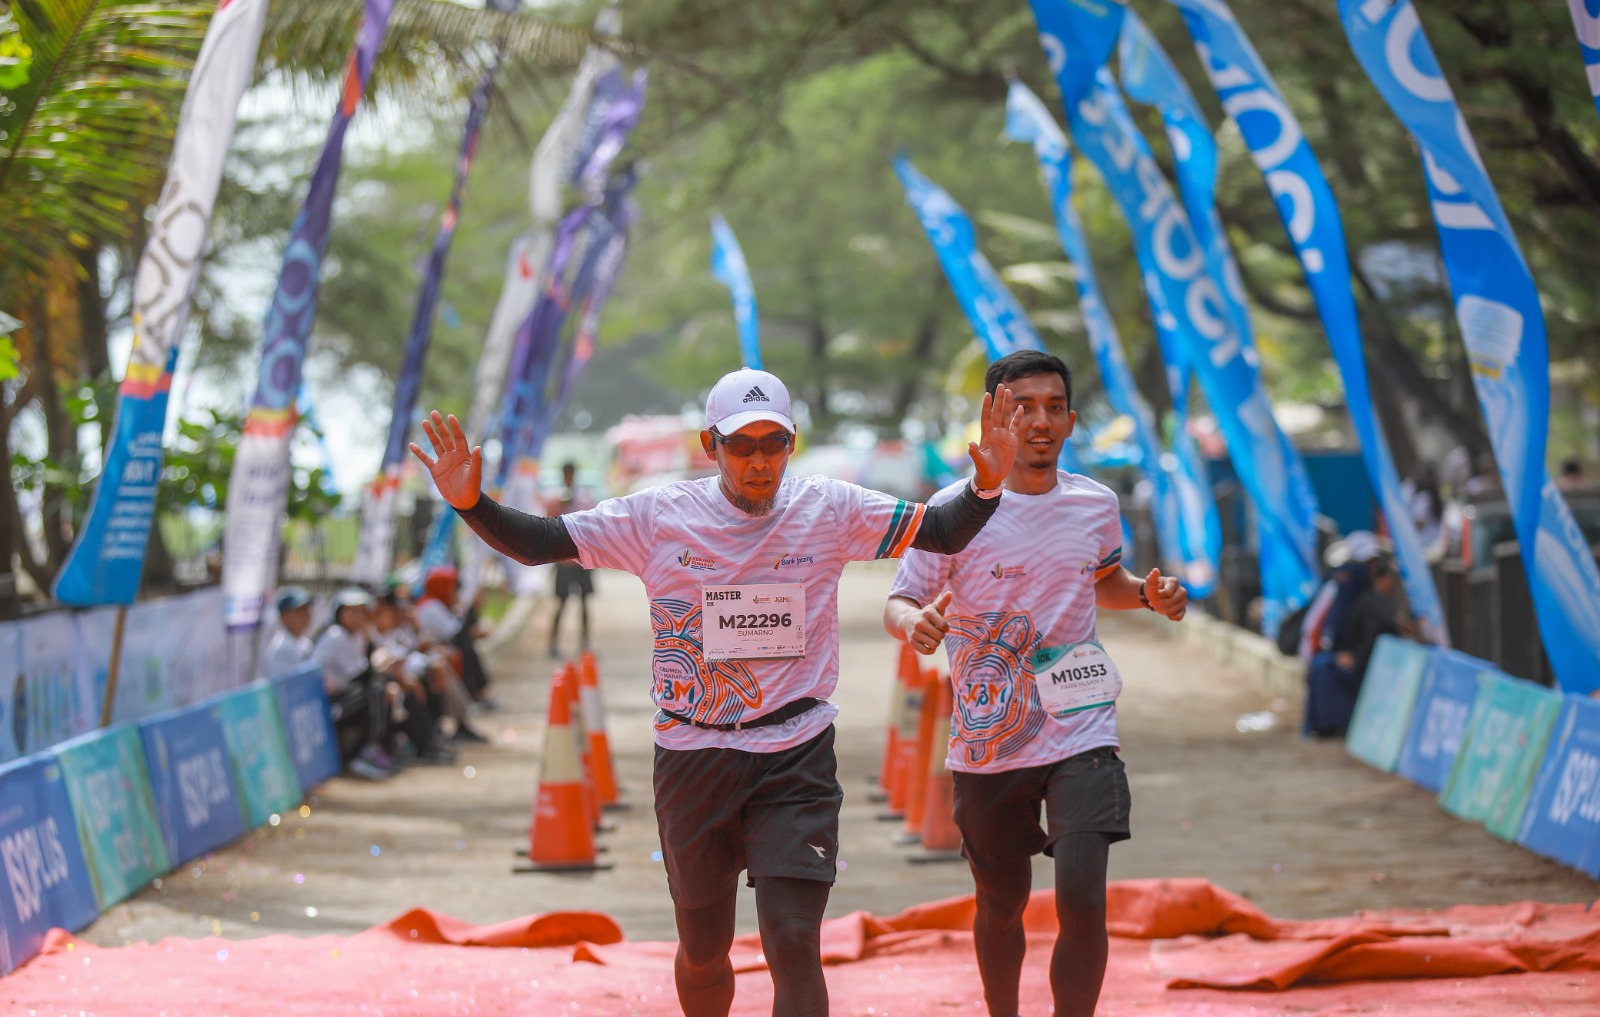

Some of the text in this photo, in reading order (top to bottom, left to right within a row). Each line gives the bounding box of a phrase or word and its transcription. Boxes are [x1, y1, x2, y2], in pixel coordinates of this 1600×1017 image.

[742, 395, 770, 403] adidas
[781, 558, 796, 566] Bank
[705, 590, 742, 600] MASTER
[719, 612, 792, 629] M22296
[737, 629, 774, 637] SUMARNO
[1036, 653, 1052, 663] 10K
[1051, 663, 1107, 685] M10353
